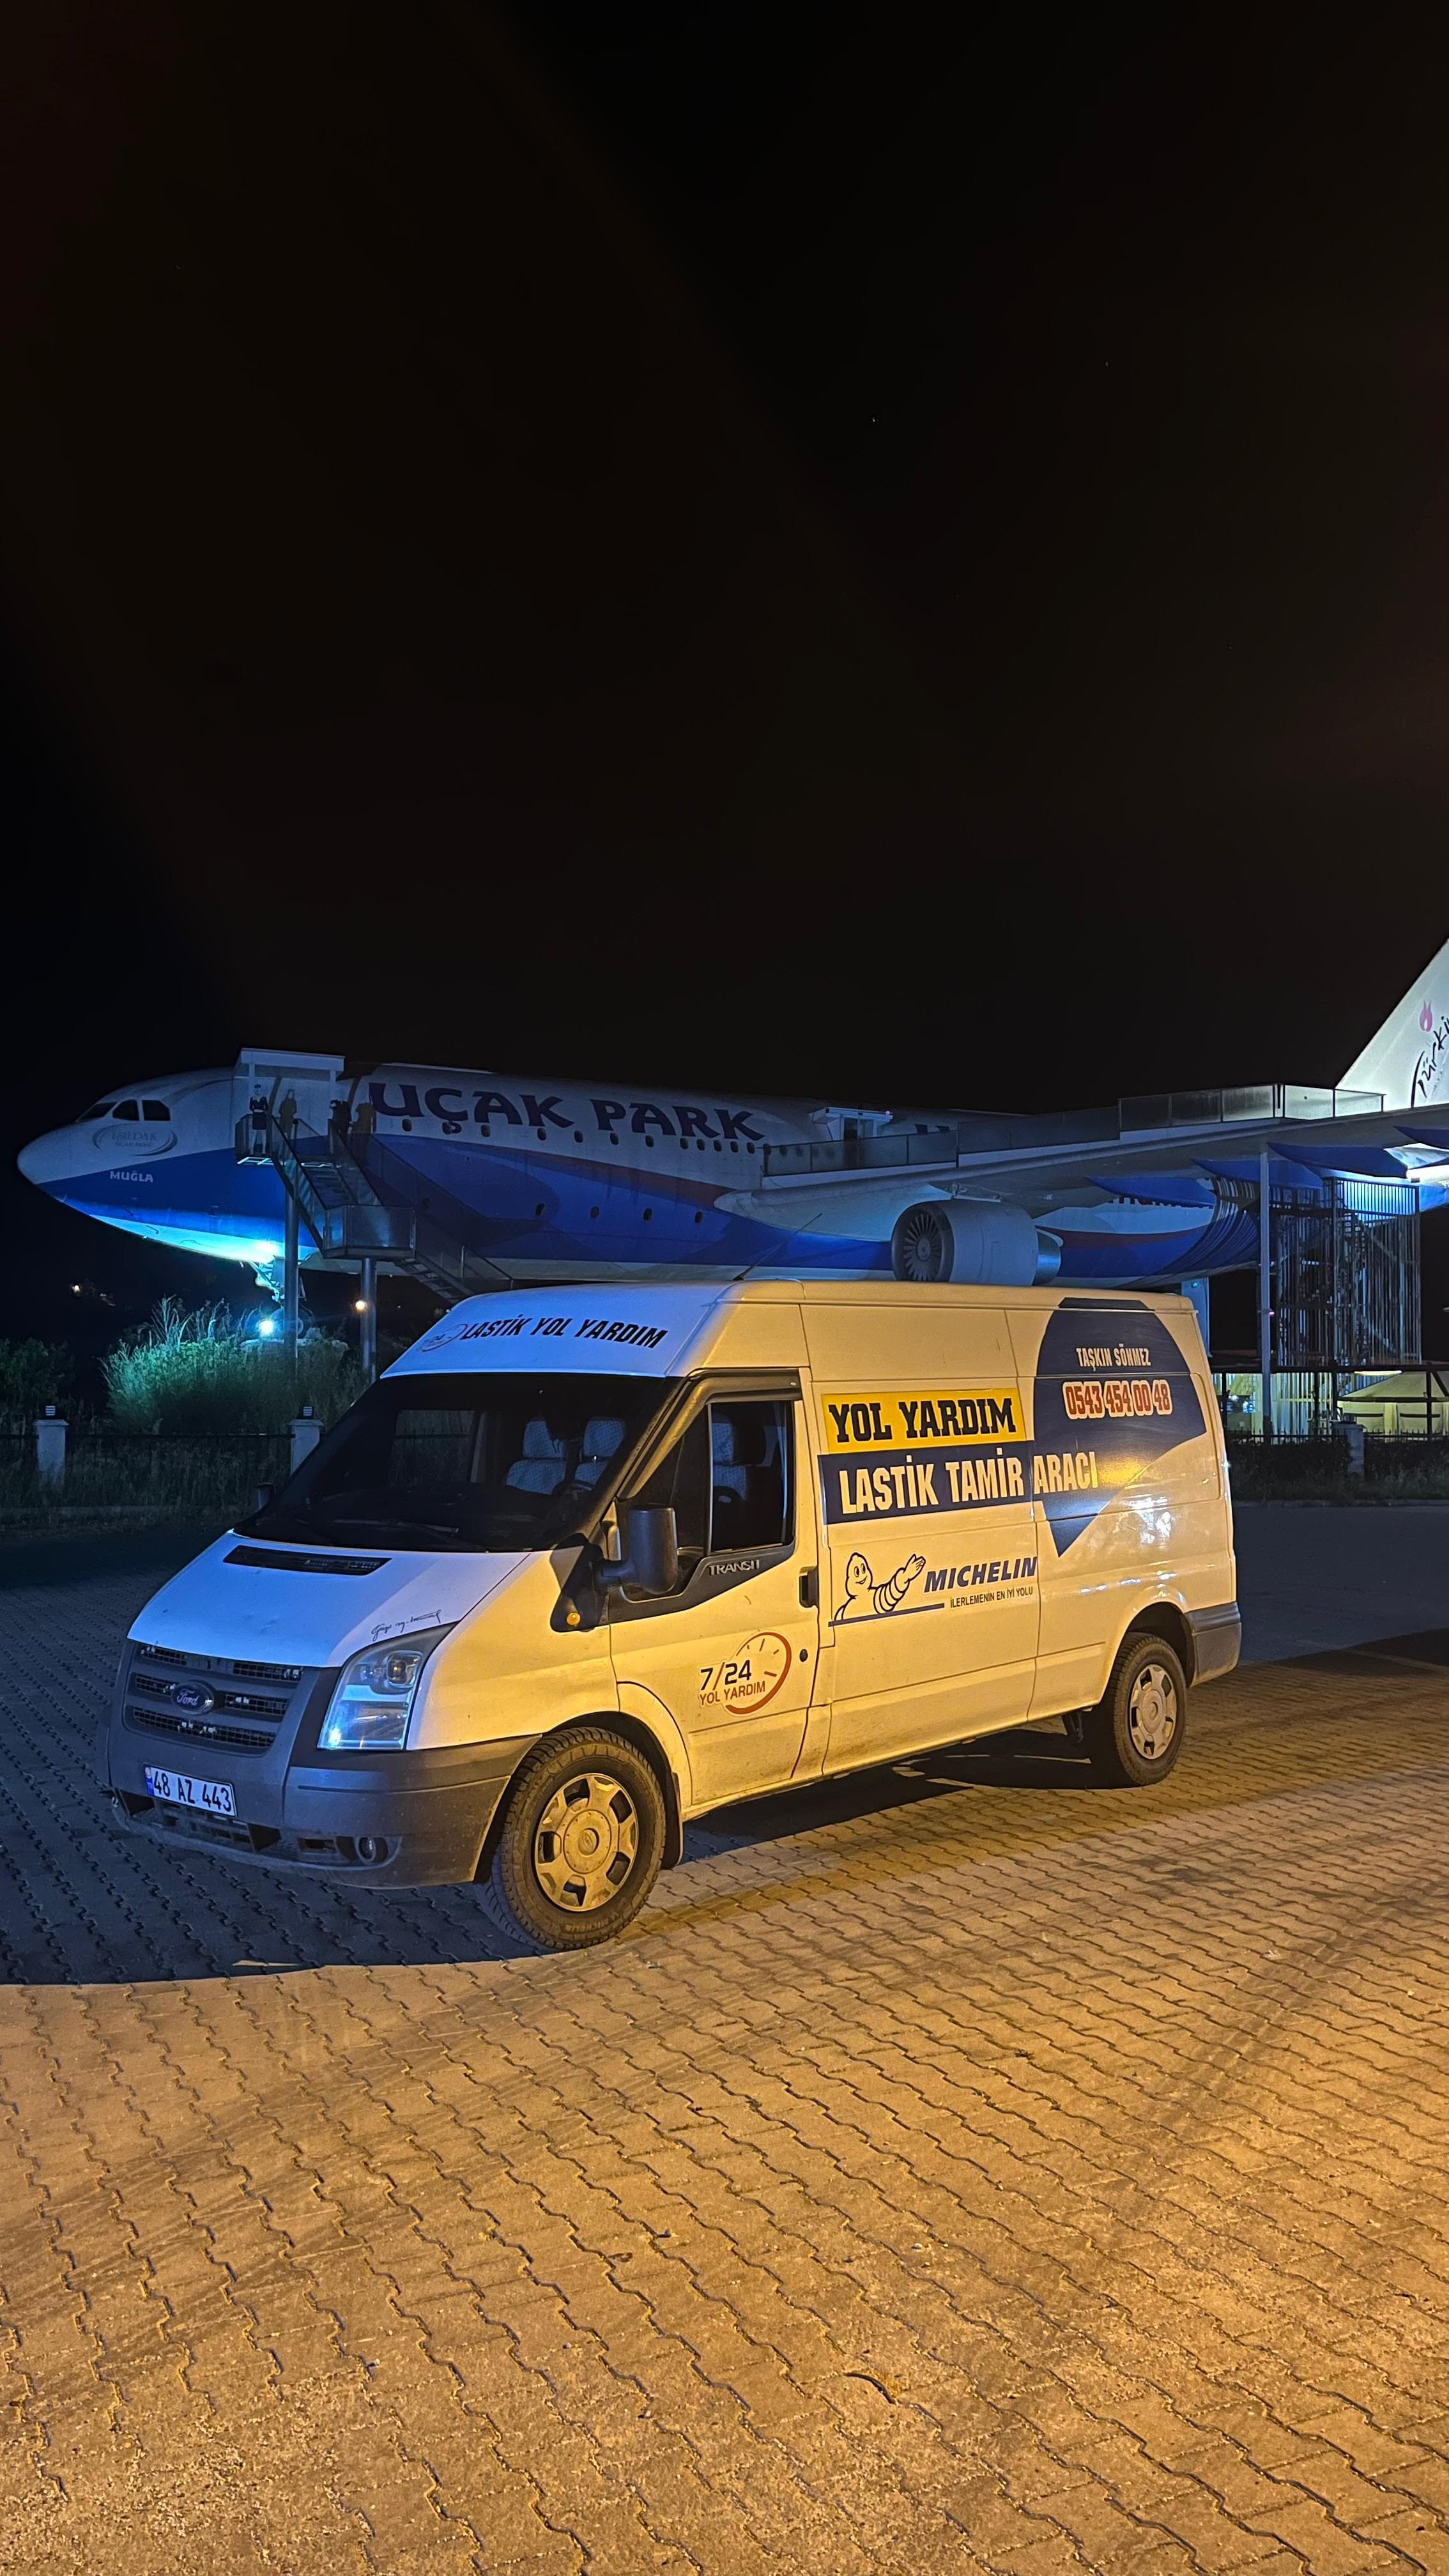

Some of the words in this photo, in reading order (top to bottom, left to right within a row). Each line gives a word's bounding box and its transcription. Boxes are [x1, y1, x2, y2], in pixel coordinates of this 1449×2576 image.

[369, 1083, 574, 1133] UÇAK
[589, 1099, 765, 1141] PARK
[109, 1170, 154, 1183] MUĞLA
[459, 1314, 533, 1340] LASTİK
[530, 1317, 573, 1337] YOL
[574, 1319, 668, 1349] YARDIM
[1076, 1347, 1113, 1372] TAŞKIN
[1114, 1343, 1151, 1367] SÖNMEZ
[1064, 1384, 1103, 1416] 0543
[1105, 1383, 1133, 1414] 454
[1133, 1383, 1152, 1413] 00
[1153, 1382, 1171, 1411] 48
[827, 1402, 893, 1443] YOL
[898, 1398, 1016, 1439] YARDIM
[839, 1455, 939, 1515] LASTİK
[945, 1446, 1024, 1503] TAMİR
[1033, 1451, 1098, 1494] ARACI
[924, 1556, 1038, 1593] MICHELIN
[950, 1591, 995, 1608] İLERLEMENİN
[997, 1590, 1005, 1600] EN
[1006, 1586, 1015, 1599] İYİ
[1016, 1586, 1033, 1597] YOLU
[700, 1659, 752, 1691] 7/24
[176, 1688, 200, 1706] Ford
[700, 1690, 721, 1705] YOL
[724, 1680, 765, 1700] YARDIM
[154, 1771, 171, 1797] 48
[178, 1777, 195, 1804] AZ
[202, 1784, 232, 1813] 443
